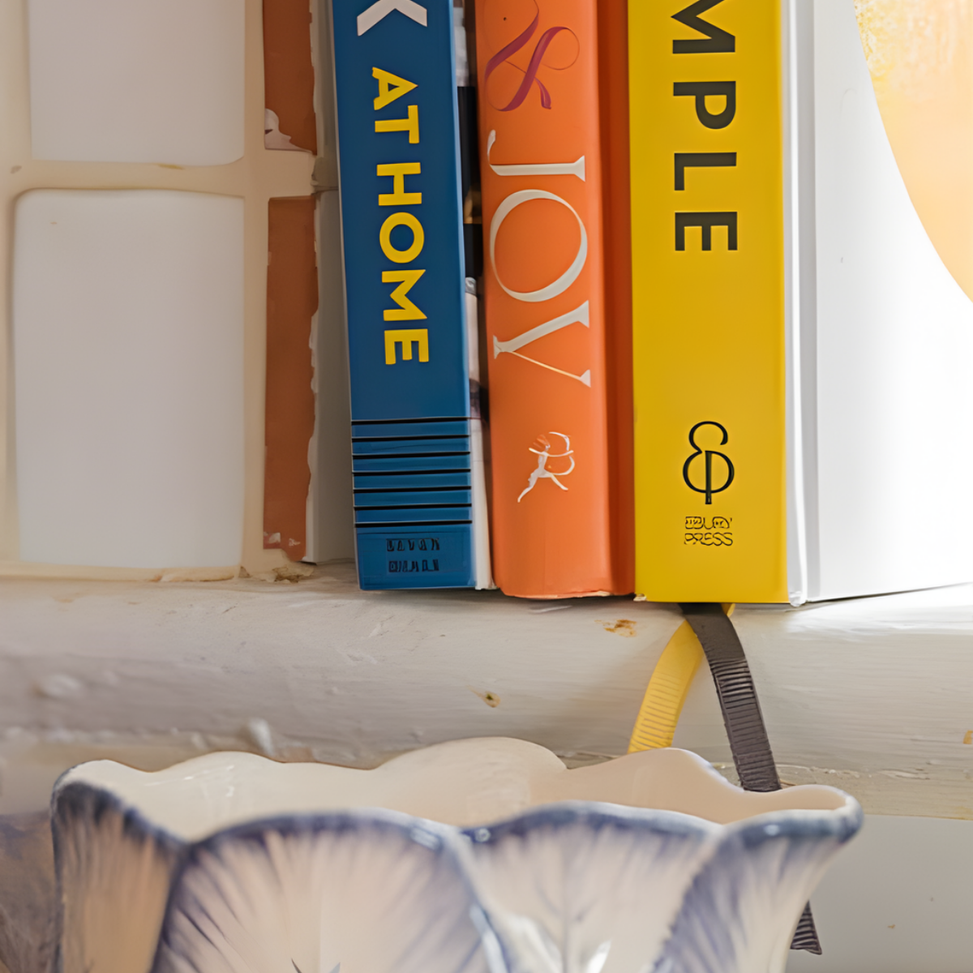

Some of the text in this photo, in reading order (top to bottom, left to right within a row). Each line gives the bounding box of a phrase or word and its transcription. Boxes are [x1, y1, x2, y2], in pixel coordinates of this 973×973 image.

[371, 66, 420, 145] AT
[376, 161, 429, 365] HOME
[487, 129, 592, 388] JOY
